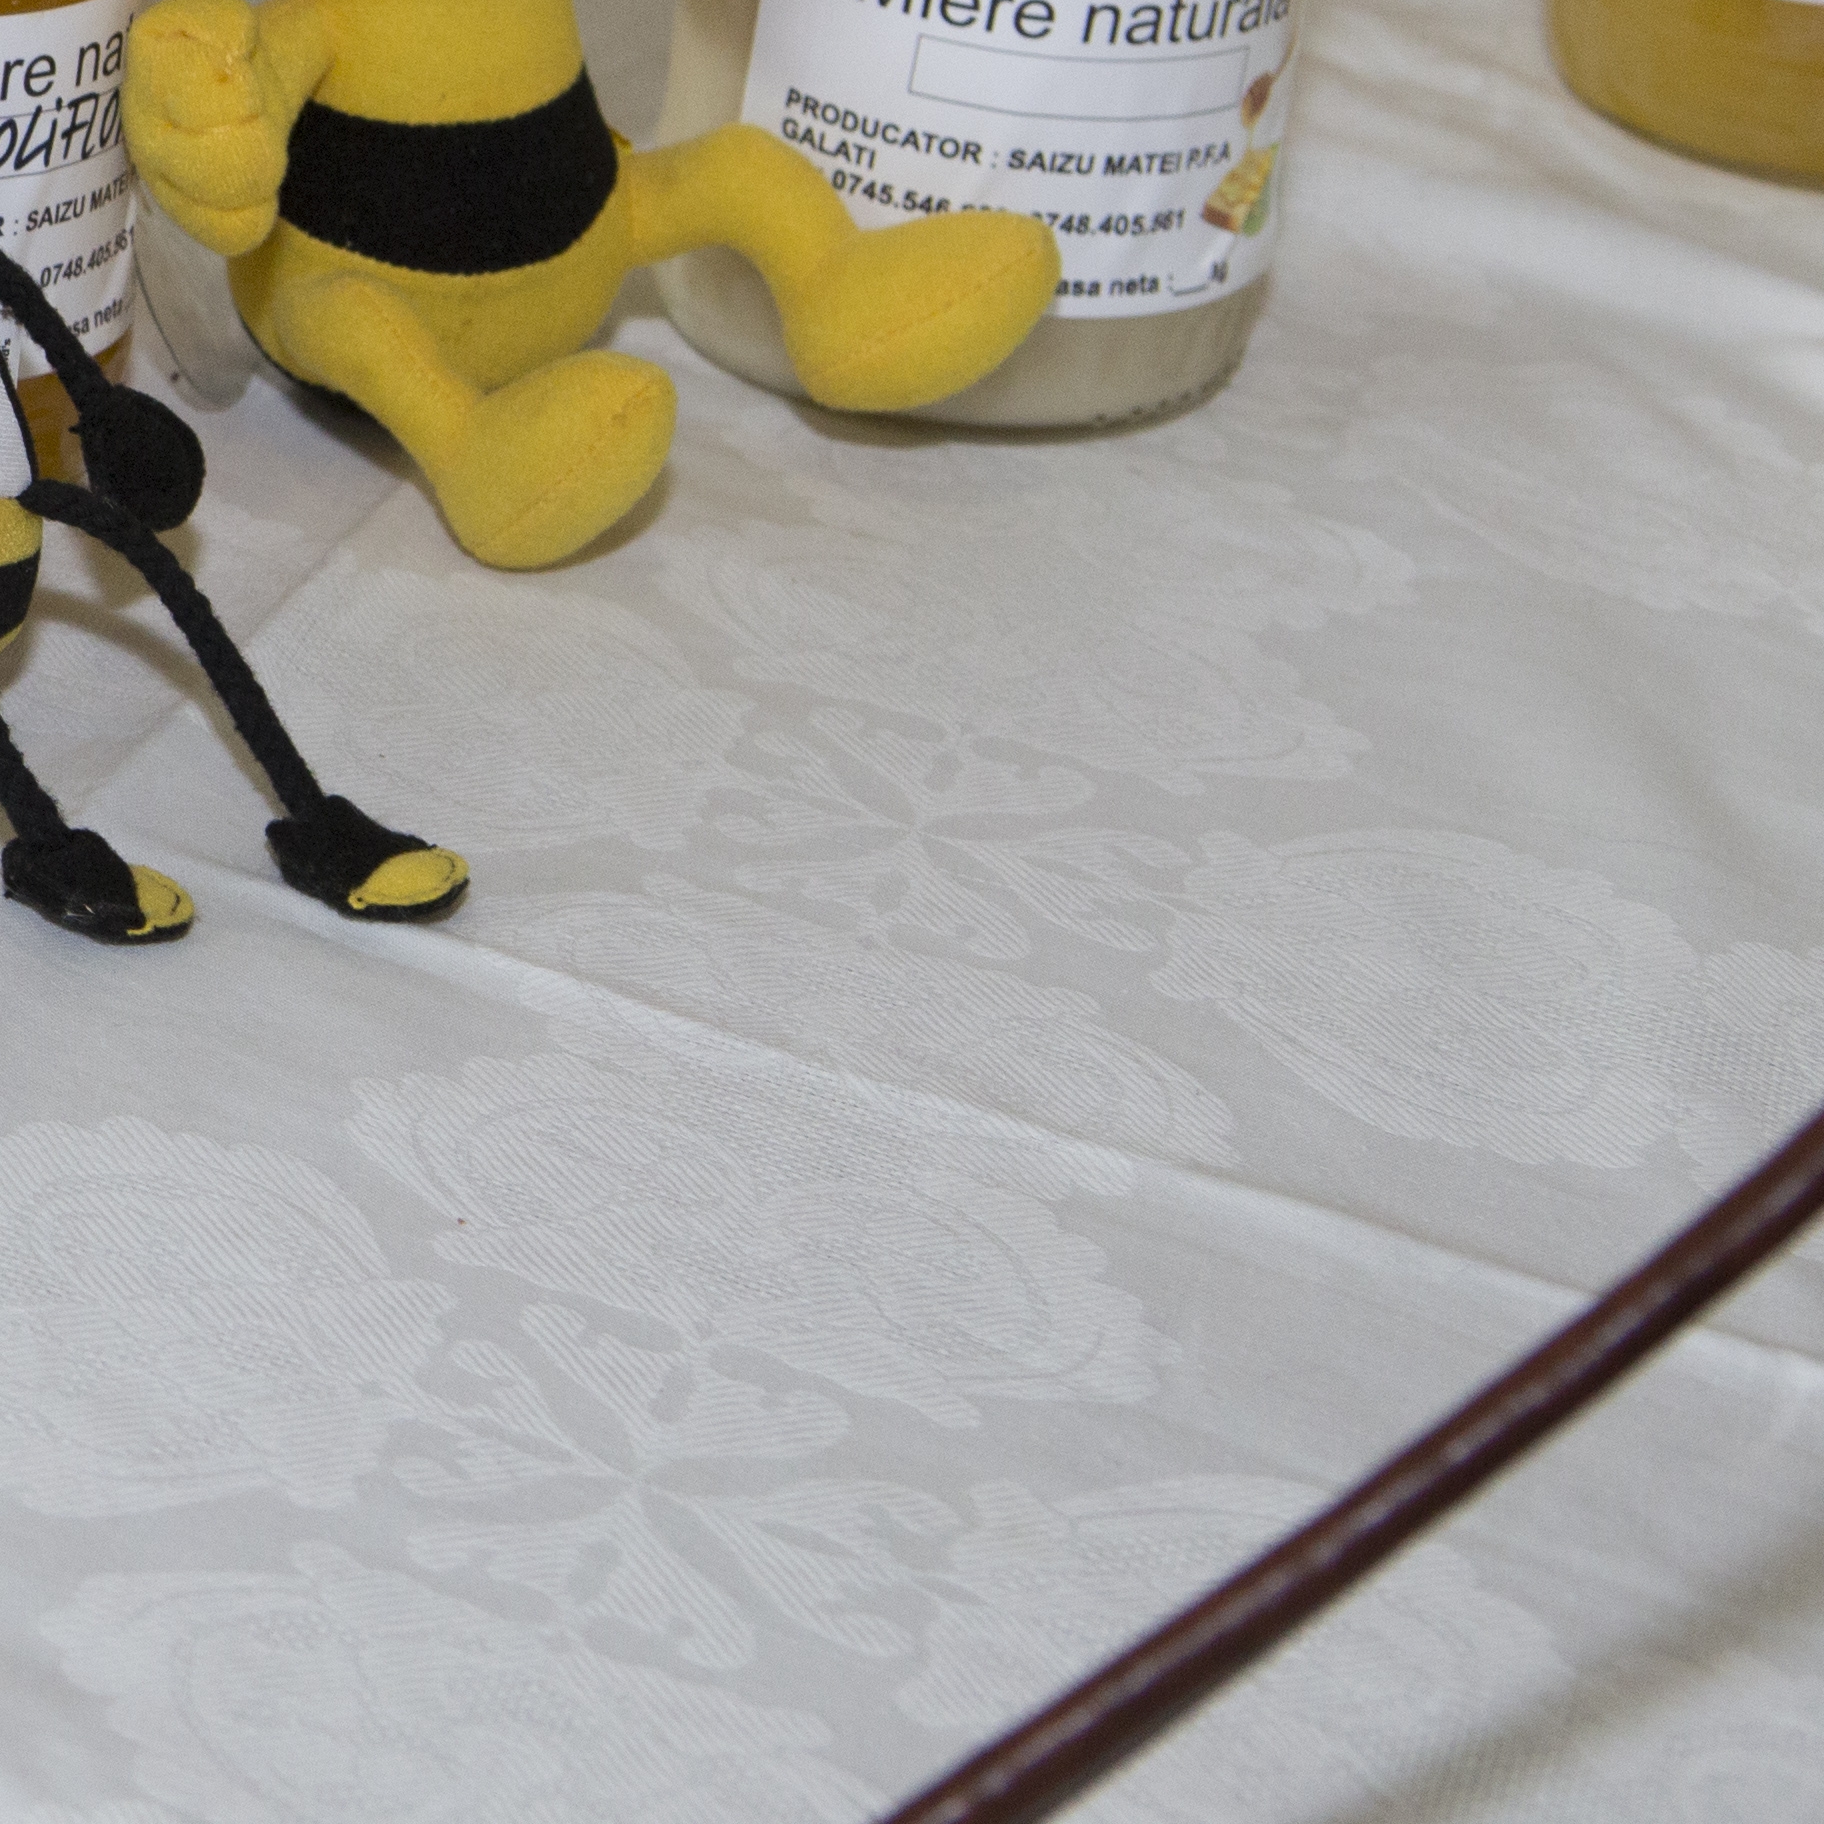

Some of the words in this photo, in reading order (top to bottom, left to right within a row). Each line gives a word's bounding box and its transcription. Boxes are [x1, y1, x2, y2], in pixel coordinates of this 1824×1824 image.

[76, 13, 134, 87] na
[782, 117, 876, 171] GALATI
[785, 87, 982, 166] PRODUCATOR
[1007, 148, 1096, 177] SAIZU
[1103, 152, 1182, 177] MATEI
[26, 195, 85, 232] SAIZU
